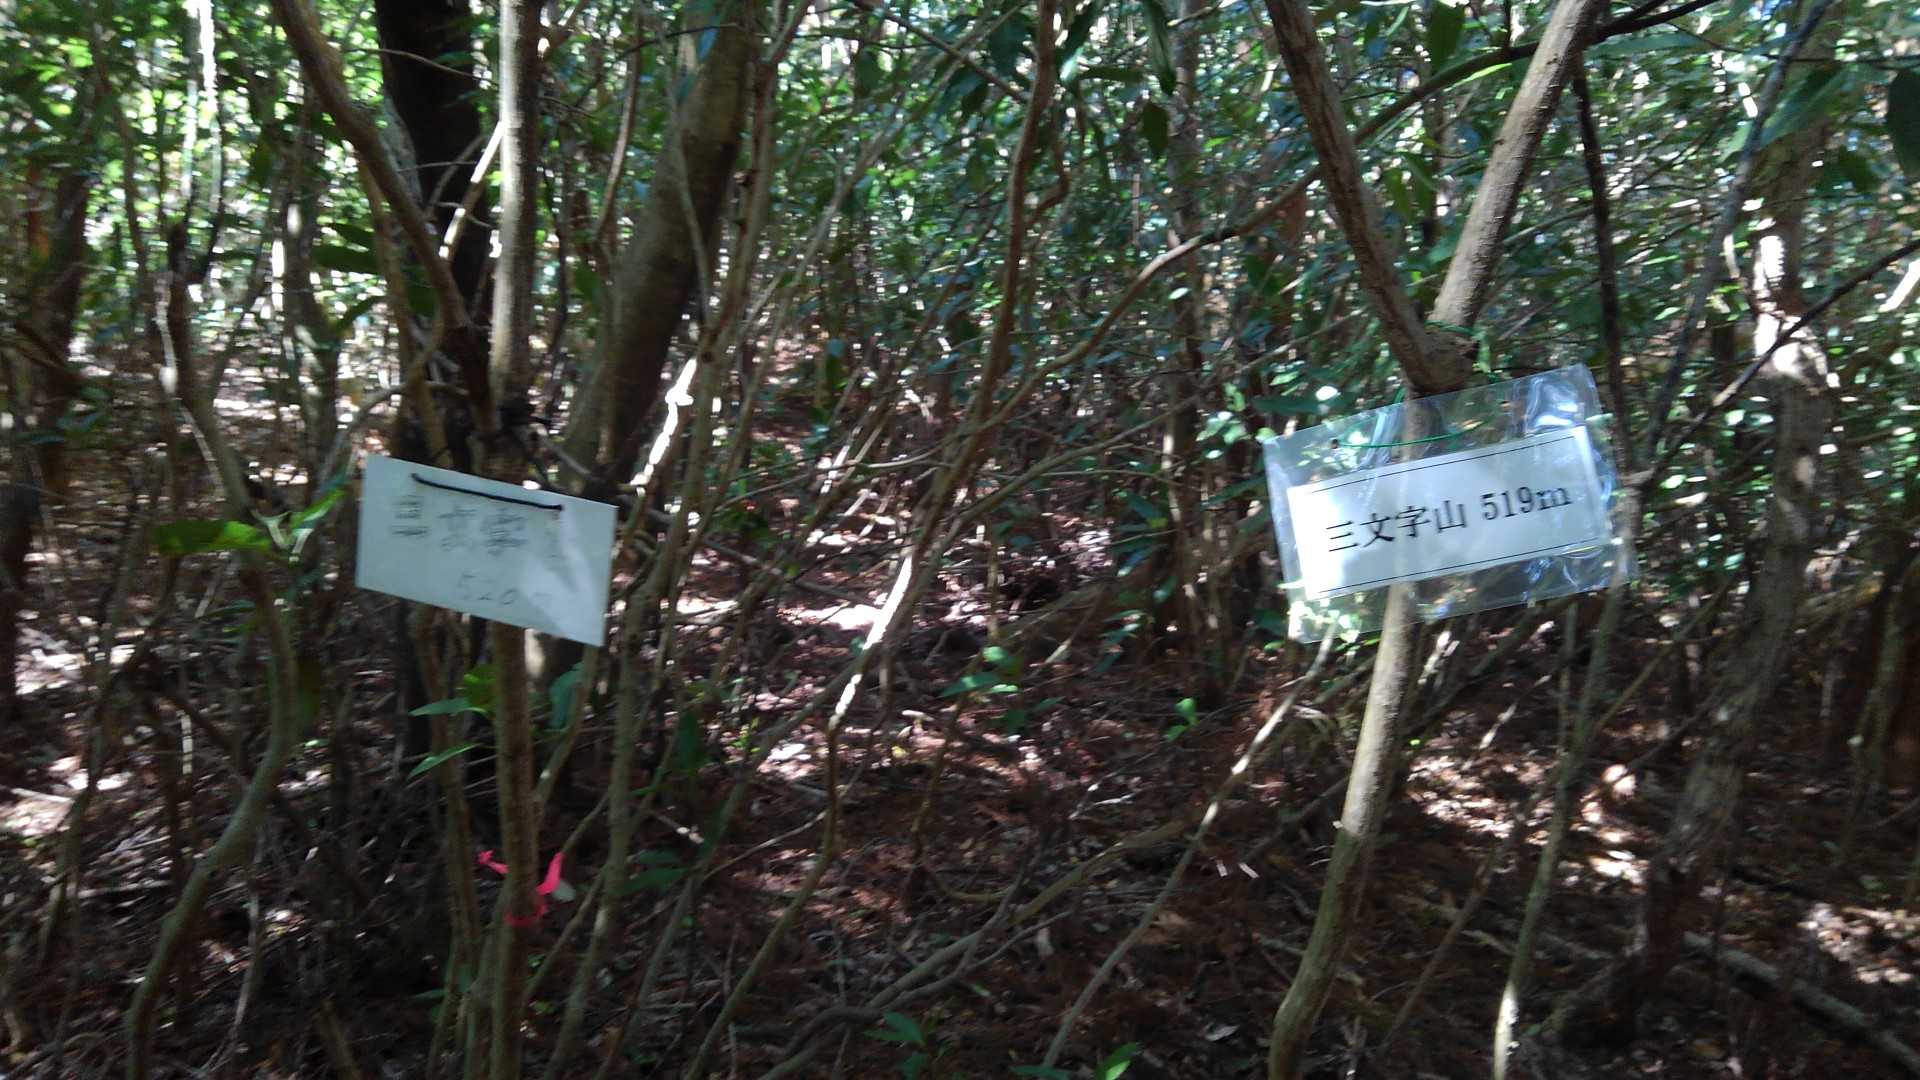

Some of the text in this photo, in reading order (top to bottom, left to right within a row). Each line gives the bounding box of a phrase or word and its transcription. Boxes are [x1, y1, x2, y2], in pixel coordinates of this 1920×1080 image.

[1325, 486, 1572, 552] 三文字山 519m
